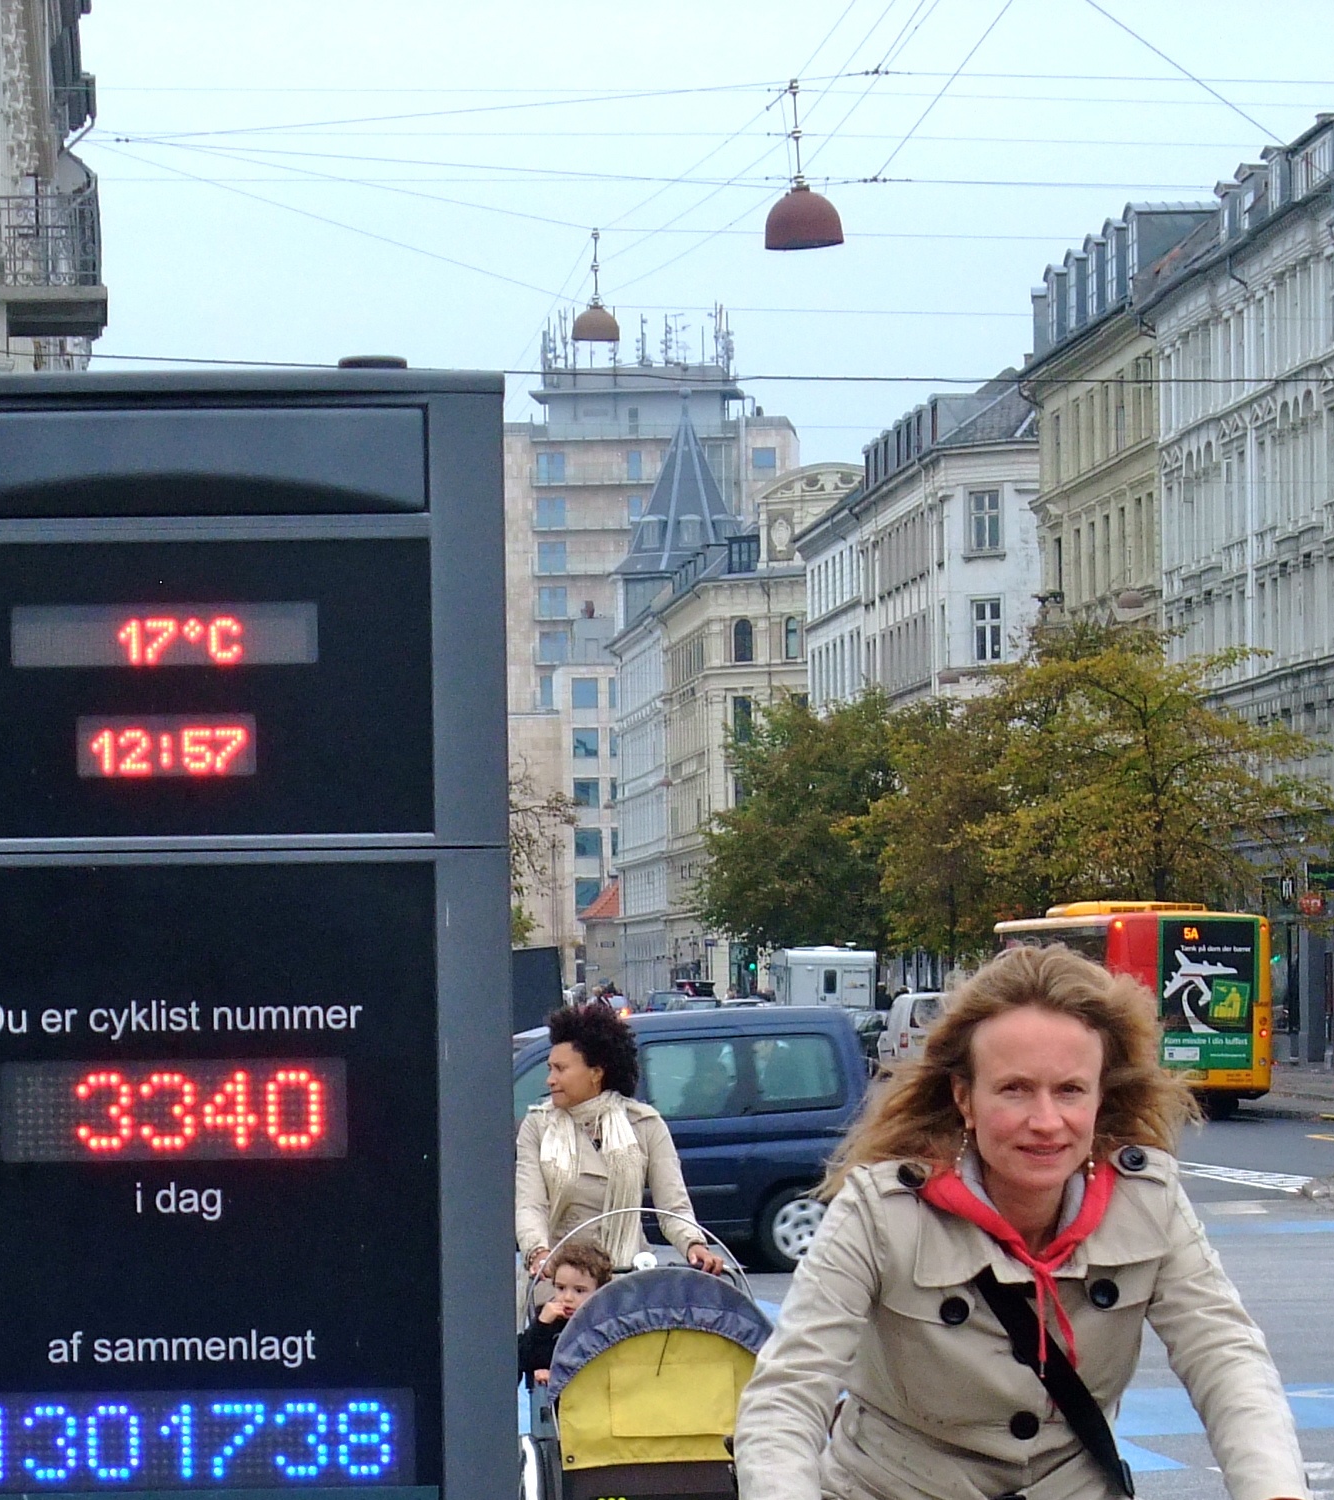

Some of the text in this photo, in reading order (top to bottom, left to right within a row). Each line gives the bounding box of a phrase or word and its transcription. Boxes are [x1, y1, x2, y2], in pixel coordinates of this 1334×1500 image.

[119, 617, 243, 666] 17°C
[91, 727, 248, 776] 12:57
[1183, 927, 1199, 940] 5A
[41, 1008, 77, 1033] er
[89, 1000, 201, 1040] cyklist
[212, 1004, 363, 1031] nummer
[75, 1069, 323, 1150] 3340
[135, 1182, 223, 1220] i dag
[48, 1330, 316, 1368] af sammenlagt
